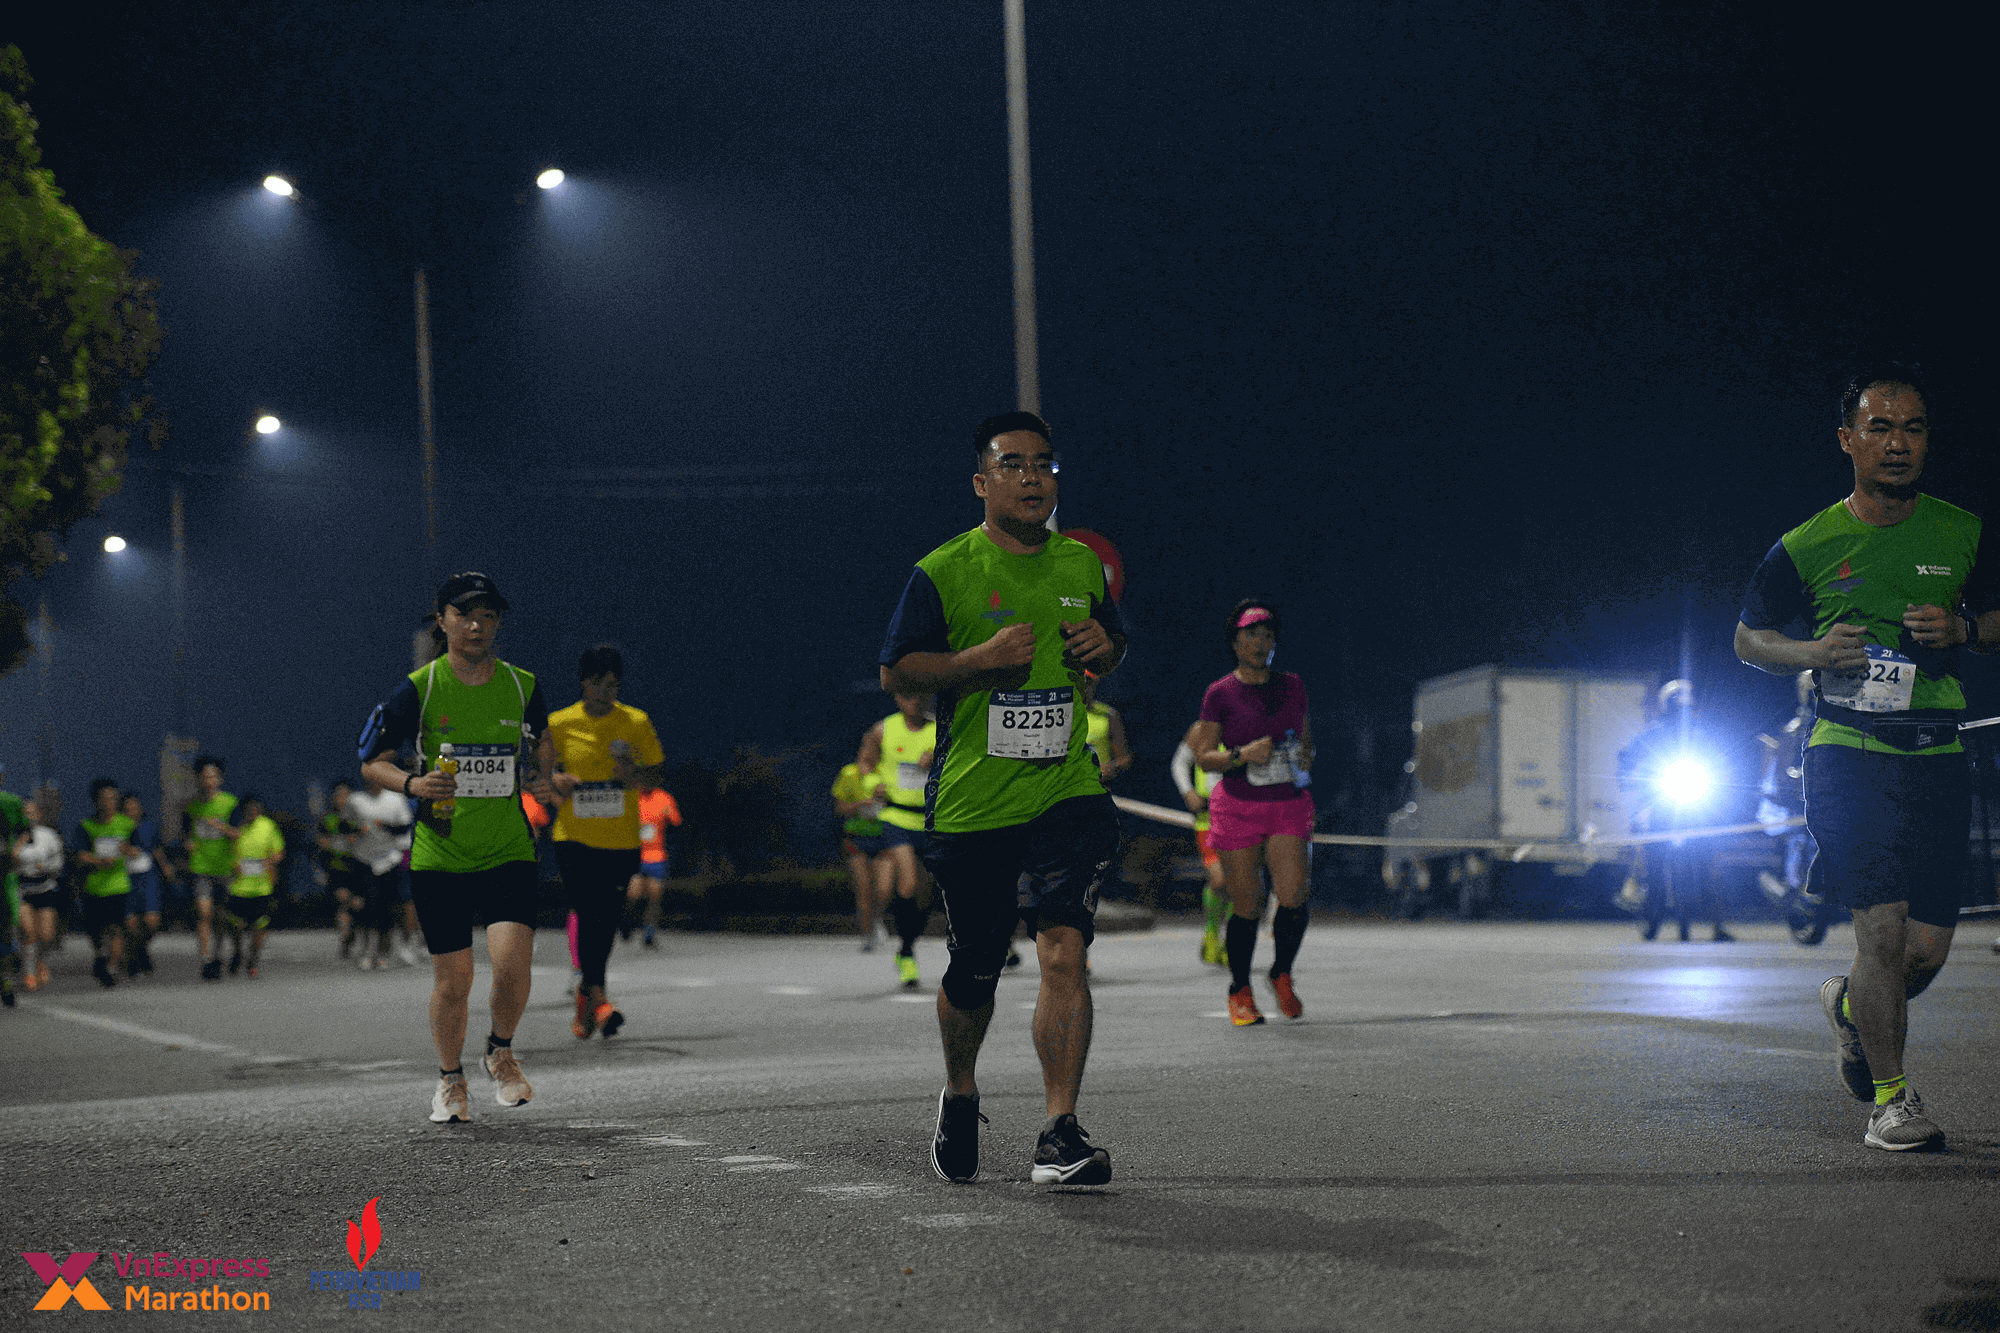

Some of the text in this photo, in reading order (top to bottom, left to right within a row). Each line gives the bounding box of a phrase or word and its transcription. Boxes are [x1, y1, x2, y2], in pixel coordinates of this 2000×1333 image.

[1881, 649, 1893, 658] 21
[1048, 692, 1057, 702] 21
[1002, 708, 1065, 729] 82253
